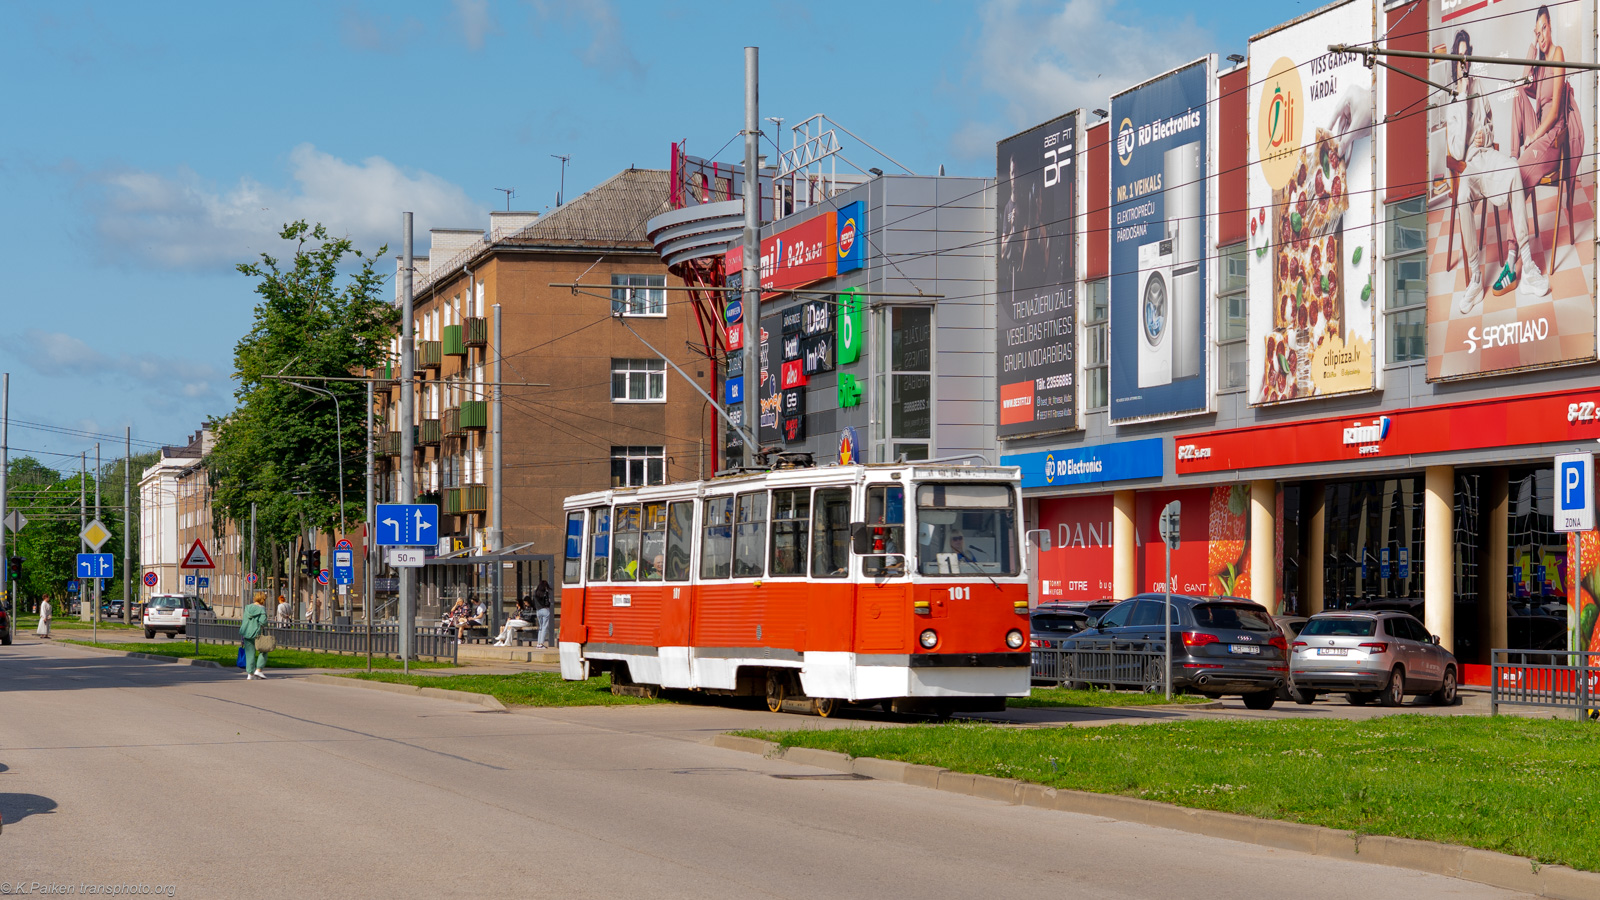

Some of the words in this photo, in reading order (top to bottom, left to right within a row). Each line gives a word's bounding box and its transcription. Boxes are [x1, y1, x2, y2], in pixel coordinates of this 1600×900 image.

[1310, 75, 1337, 101] VĀRDĀ!
[1138, 123, 1152, 147] RD
[1152, 107, 1201, 142] Electronics
[1117, 184, 1128, 202] NR.
[1129, 183, 1134, 198] 1
[1134, 173, 1162, 196] VEIKALS
[787, 241, 804, 268] 8-22
[1013, 294, 1054, 319] TRENAŽIERU
[1055, 288, 1072, 311] ZĀLE
[807, 302, 828, 335] iDeal
[1006, 323, 1043, 346] VESELĪBAS
[1043, 316, 1072, 339] FITNESS
[1482, 318, 1549, 349] SPORTLAND
[1003, 351, 1027, 372] GRUPU
[1028, 342, 1072, 367] NODARBĪBAS
[1323, 345, 1361, 369] cilipizza.lv
[1567, 401, 1595, 422] 8-22
[1057, 461, 1067, 476] RD
[1067, 456, 1103, 475] Electronics
[1566, 467, 1580, 504] P
[1565, 518, 1581, 528] ZONA
[397, 554, 408, 562] 50
[945, 556, 953, 573] 1
[948, 586, 970, 600] 101
[1184, 583, 1206, 592] GANT
